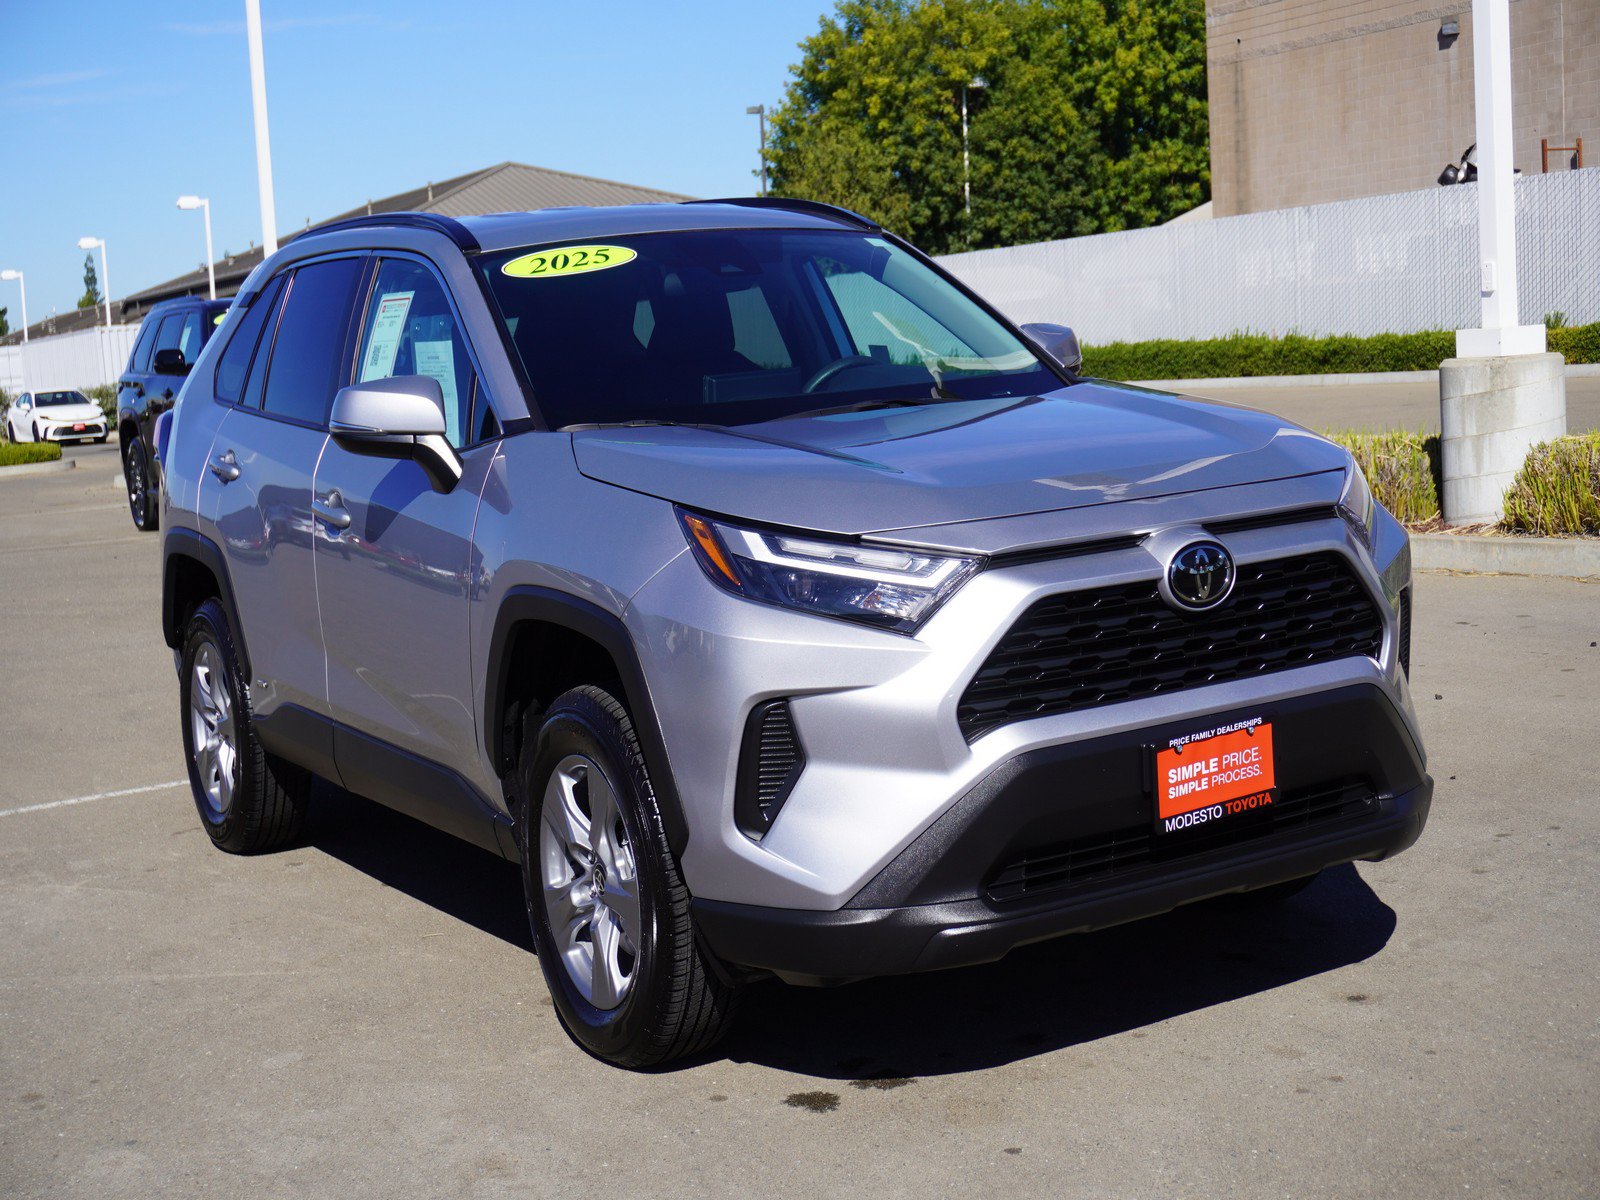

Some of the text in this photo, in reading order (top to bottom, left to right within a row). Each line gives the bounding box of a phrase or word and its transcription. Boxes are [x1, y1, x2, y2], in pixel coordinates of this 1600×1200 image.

[529, 248, 610, 275] 2025
[1169, 717, 1262, 748] PRICE FAMILY DEALERSHIPS
[1168, 757, 1219, 784] SIMPLE
[1168, 778, 1209, 799] SIMPLE
[1165, 792, 1273, 833] MODESTO TOYOTA
